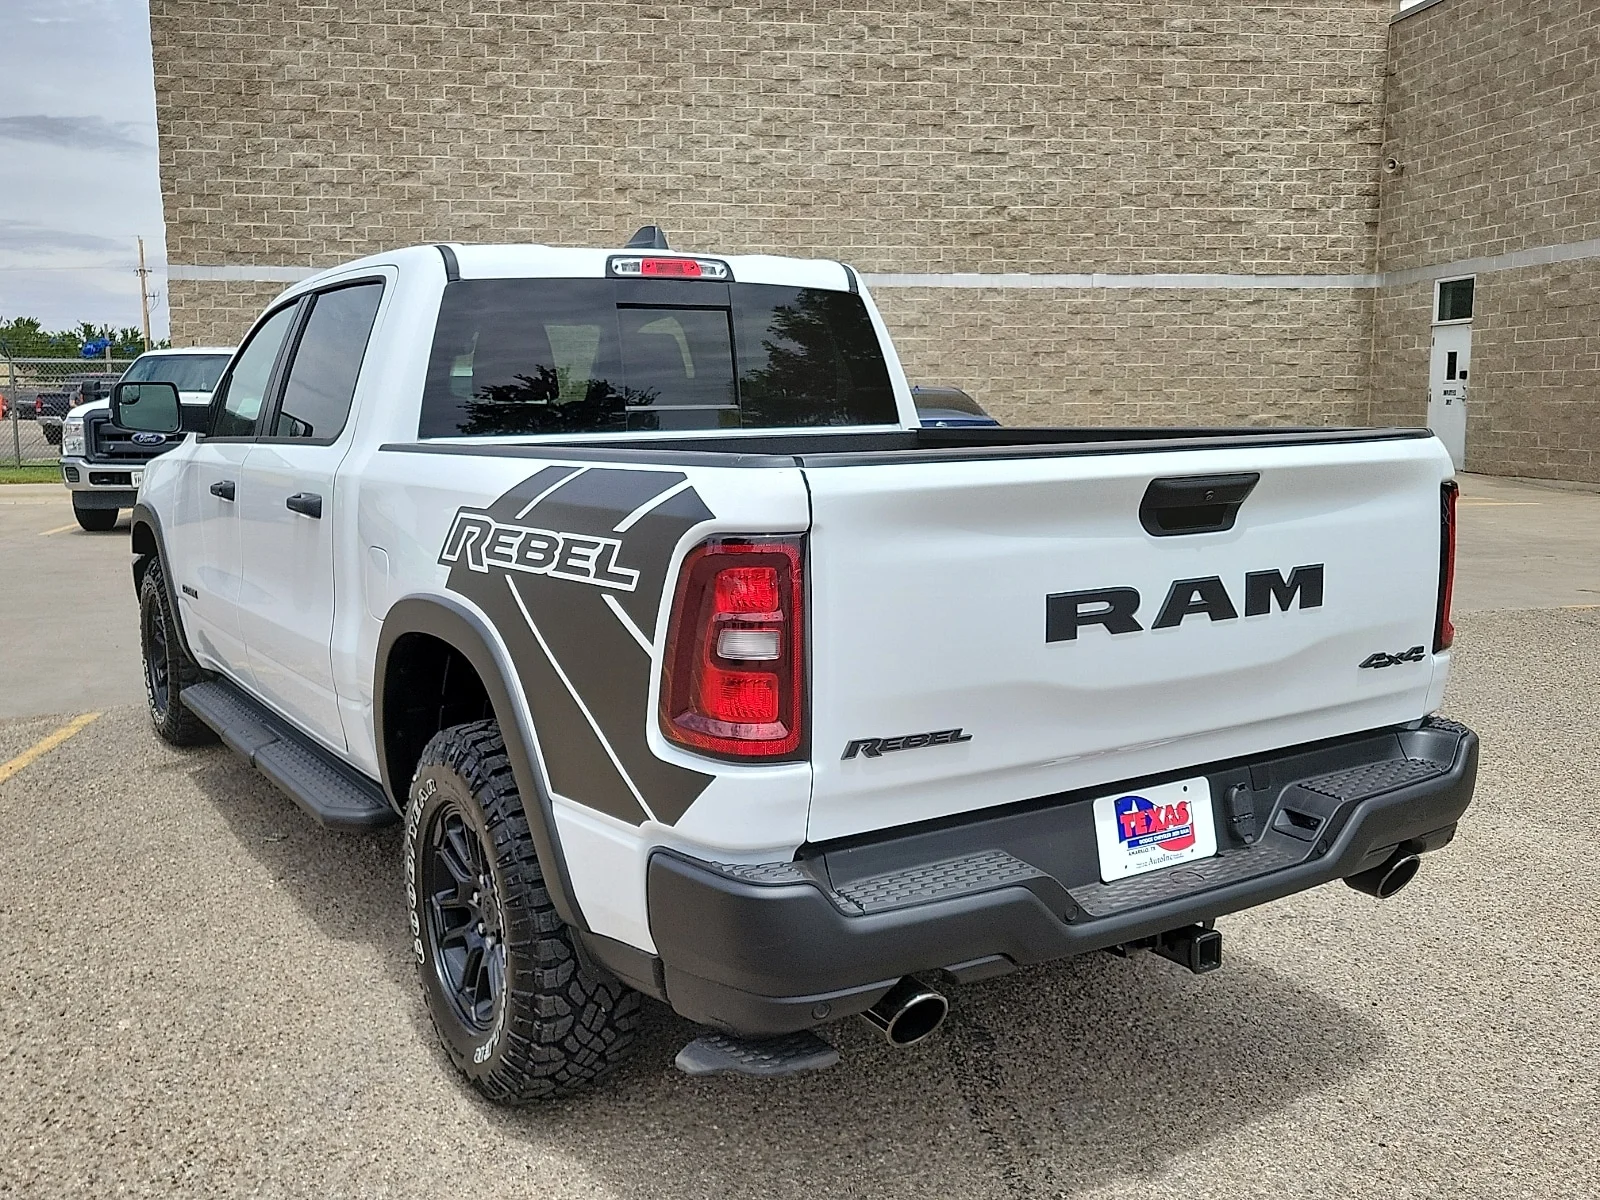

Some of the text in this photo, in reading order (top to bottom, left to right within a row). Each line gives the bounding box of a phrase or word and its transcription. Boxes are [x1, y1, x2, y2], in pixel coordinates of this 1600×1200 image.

[138, 432, 156, 440] Ford
[442, 512, 640, 592] REBEL
[1045, 562, 1325, 643] RAM
[1358, 645, 1426, 669] 4x4
[840, 728, 973, 761] REBEL
[1120, 801, 1189, 837] TEXAS
[407, 778, 438, 965] GOODYEAR
